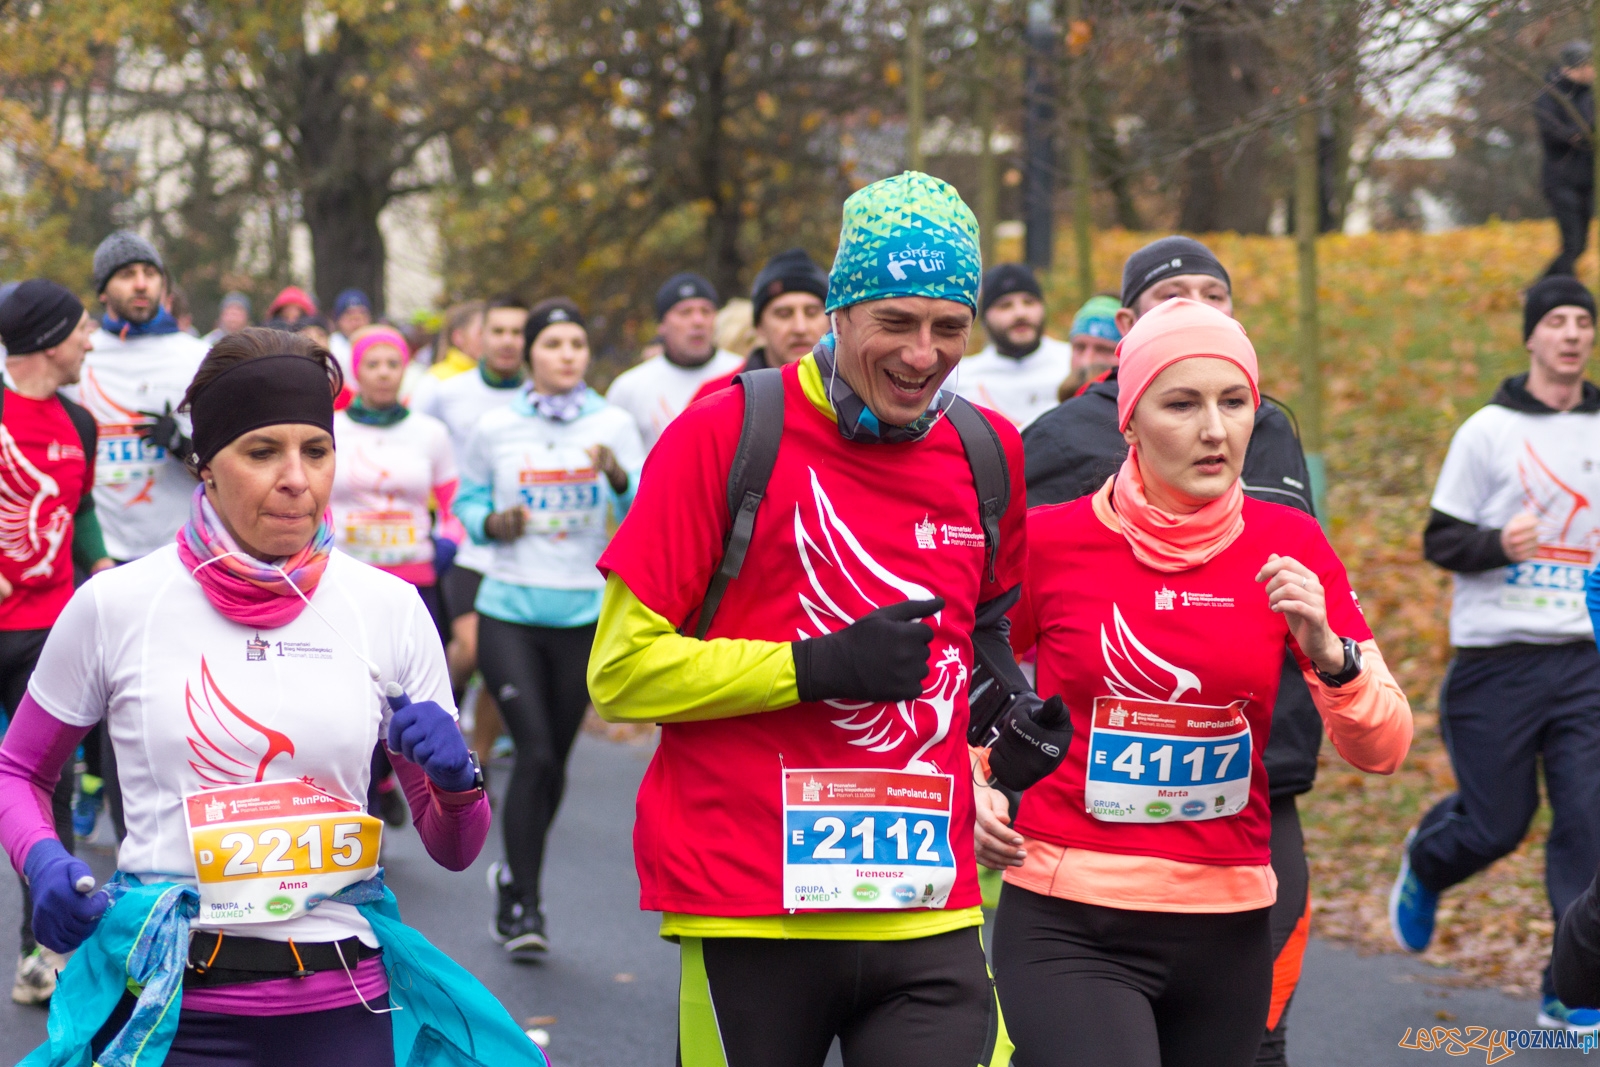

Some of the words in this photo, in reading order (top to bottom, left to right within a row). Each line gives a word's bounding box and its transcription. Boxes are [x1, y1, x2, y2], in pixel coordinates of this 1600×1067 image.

[888, 249, 946, 261] FOREST
[887, 259, 946, 281] run
[940, 524, 950, 544] 1
[1517, 563, 1585, 591] 2445
[1180, 591, 1190, 606] 1
[276, 641, 285, 657] 1
[1095, 750, 1107, 764] E
[1112, 742, 1240, 782] 4117
[827, 783, 835, 798] 1
[887, 786, 942, 802] RunPoland.org
[1158, 790, 1189, 798] Marta
[229, 800, 239, 814] 1
[1094, 800, 1121, 808] GRUPA
[1094, 807, 1125, 816] LUXMED
[792, 830, 804, 845] E
[812, 816, 940, 862] 2112
[200, 850, 214, 865] D
[220, 822, 362, 877] 2215
[856, 869, 904, 878] Ireneusz
[279, 881, 308, 890] Anna
[795, 886, 825, 894] GRUPA
[211, 902, 239, 910] GRUPA
[211, 910, 244, 919] LUXMED
